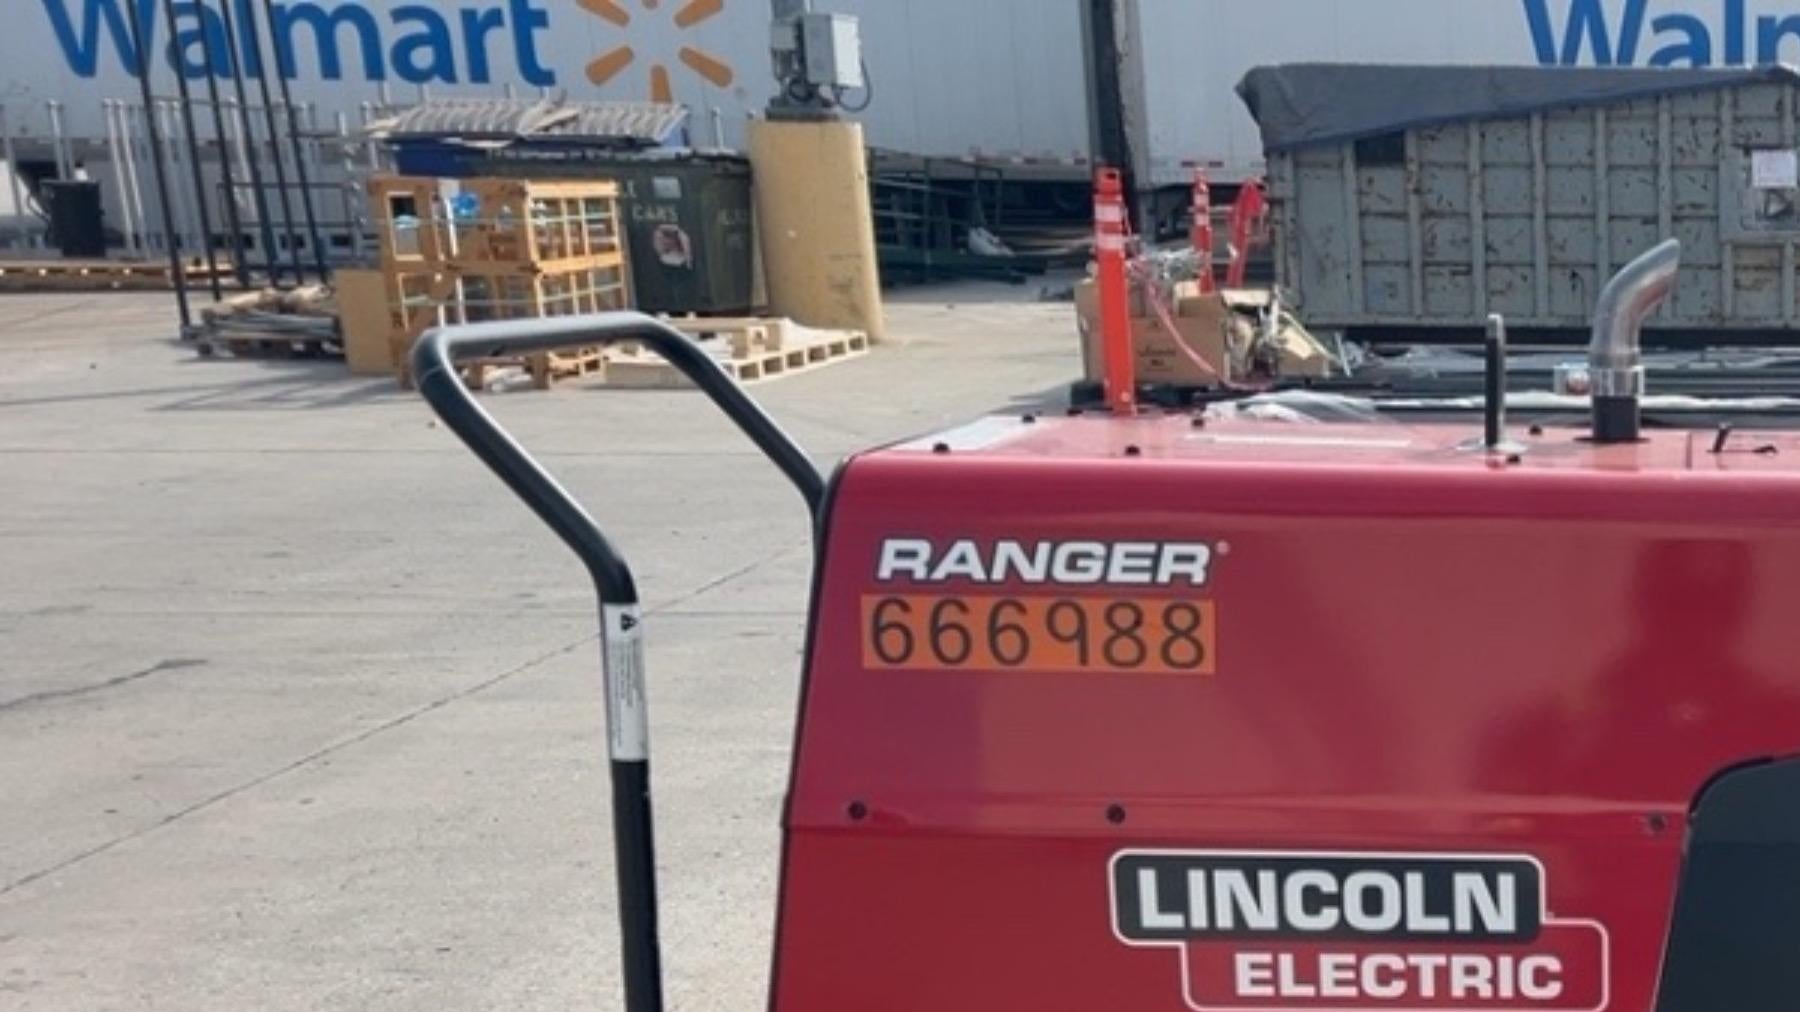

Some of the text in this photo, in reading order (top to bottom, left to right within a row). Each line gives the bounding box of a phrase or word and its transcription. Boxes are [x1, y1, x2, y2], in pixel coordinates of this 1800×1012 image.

[42, 0, 556, 86] Walmart
[877, 538, 1210, 585] RANGER
[871, 597, 1205, 671] 666988
[1137, 868, 1517, 934] LINCOLN
[1234, 952, 1564, 1000] ELECTRIC
